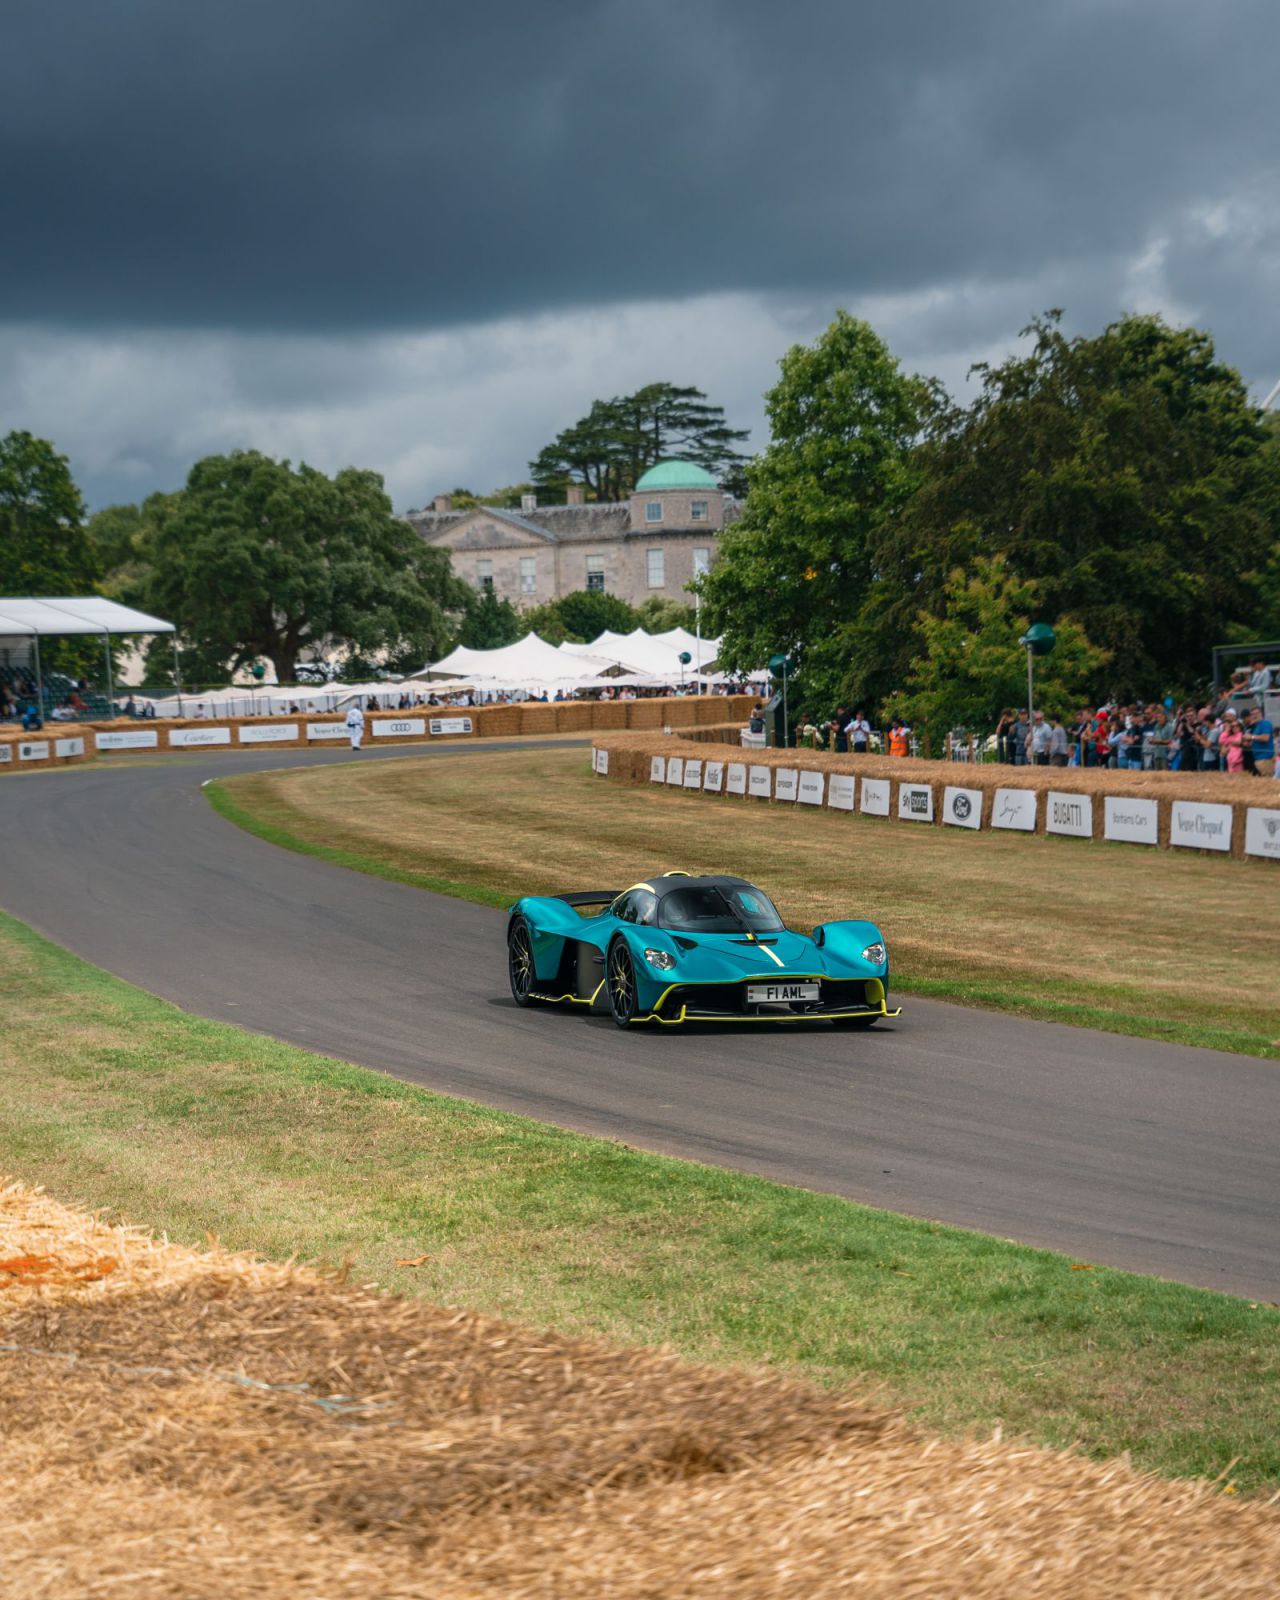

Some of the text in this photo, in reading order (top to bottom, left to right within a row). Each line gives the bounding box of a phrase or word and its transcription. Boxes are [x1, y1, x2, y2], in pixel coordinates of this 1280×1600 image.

[1053, 802, 1082, 827] BUGATTI
[767, 986, 806, 999] F1 AML
